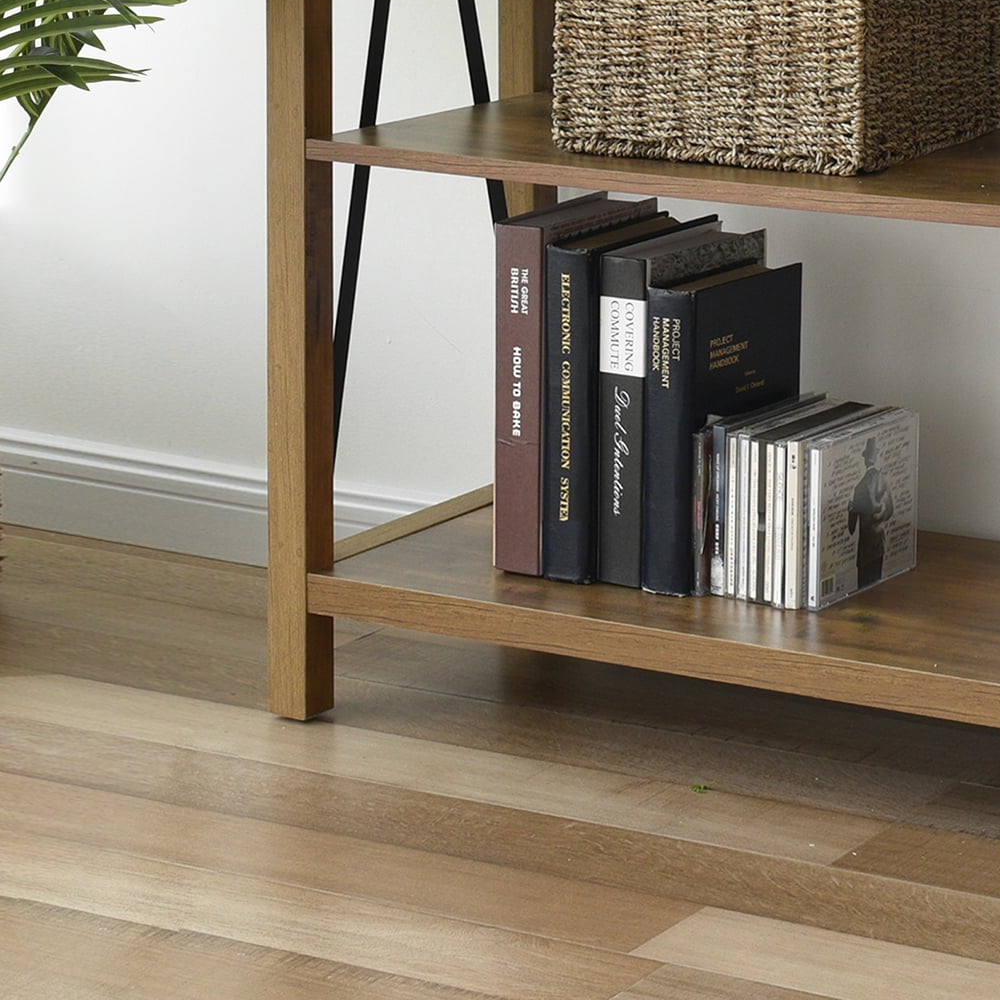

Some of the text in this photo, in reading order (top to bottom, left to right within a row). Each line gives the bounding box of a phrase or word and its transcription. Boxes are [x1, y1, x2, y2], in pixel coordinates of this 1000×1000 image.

[510, 267, 519, 314] BRITISH
[521, 286, 529, 315] GREAT
[561, 274, 571, 354] ELECTRONIC
[609, 300, 620, 369] COMMUTE
[625, 302, 634, 372] COVERING
[652, 316, 660, 371] HANDBOOK
[661, 317, 670, 389] MANAGEMENT
[671, 318, 680, 361] PROJECT
[709, 334, 734, 348] PROJECT
[709, 340, 749, 359] MANAGEMENT
[512, 346, 521, 437] HOW TO BAKE
[560, 360, 571, 469] COMMUNICATION
